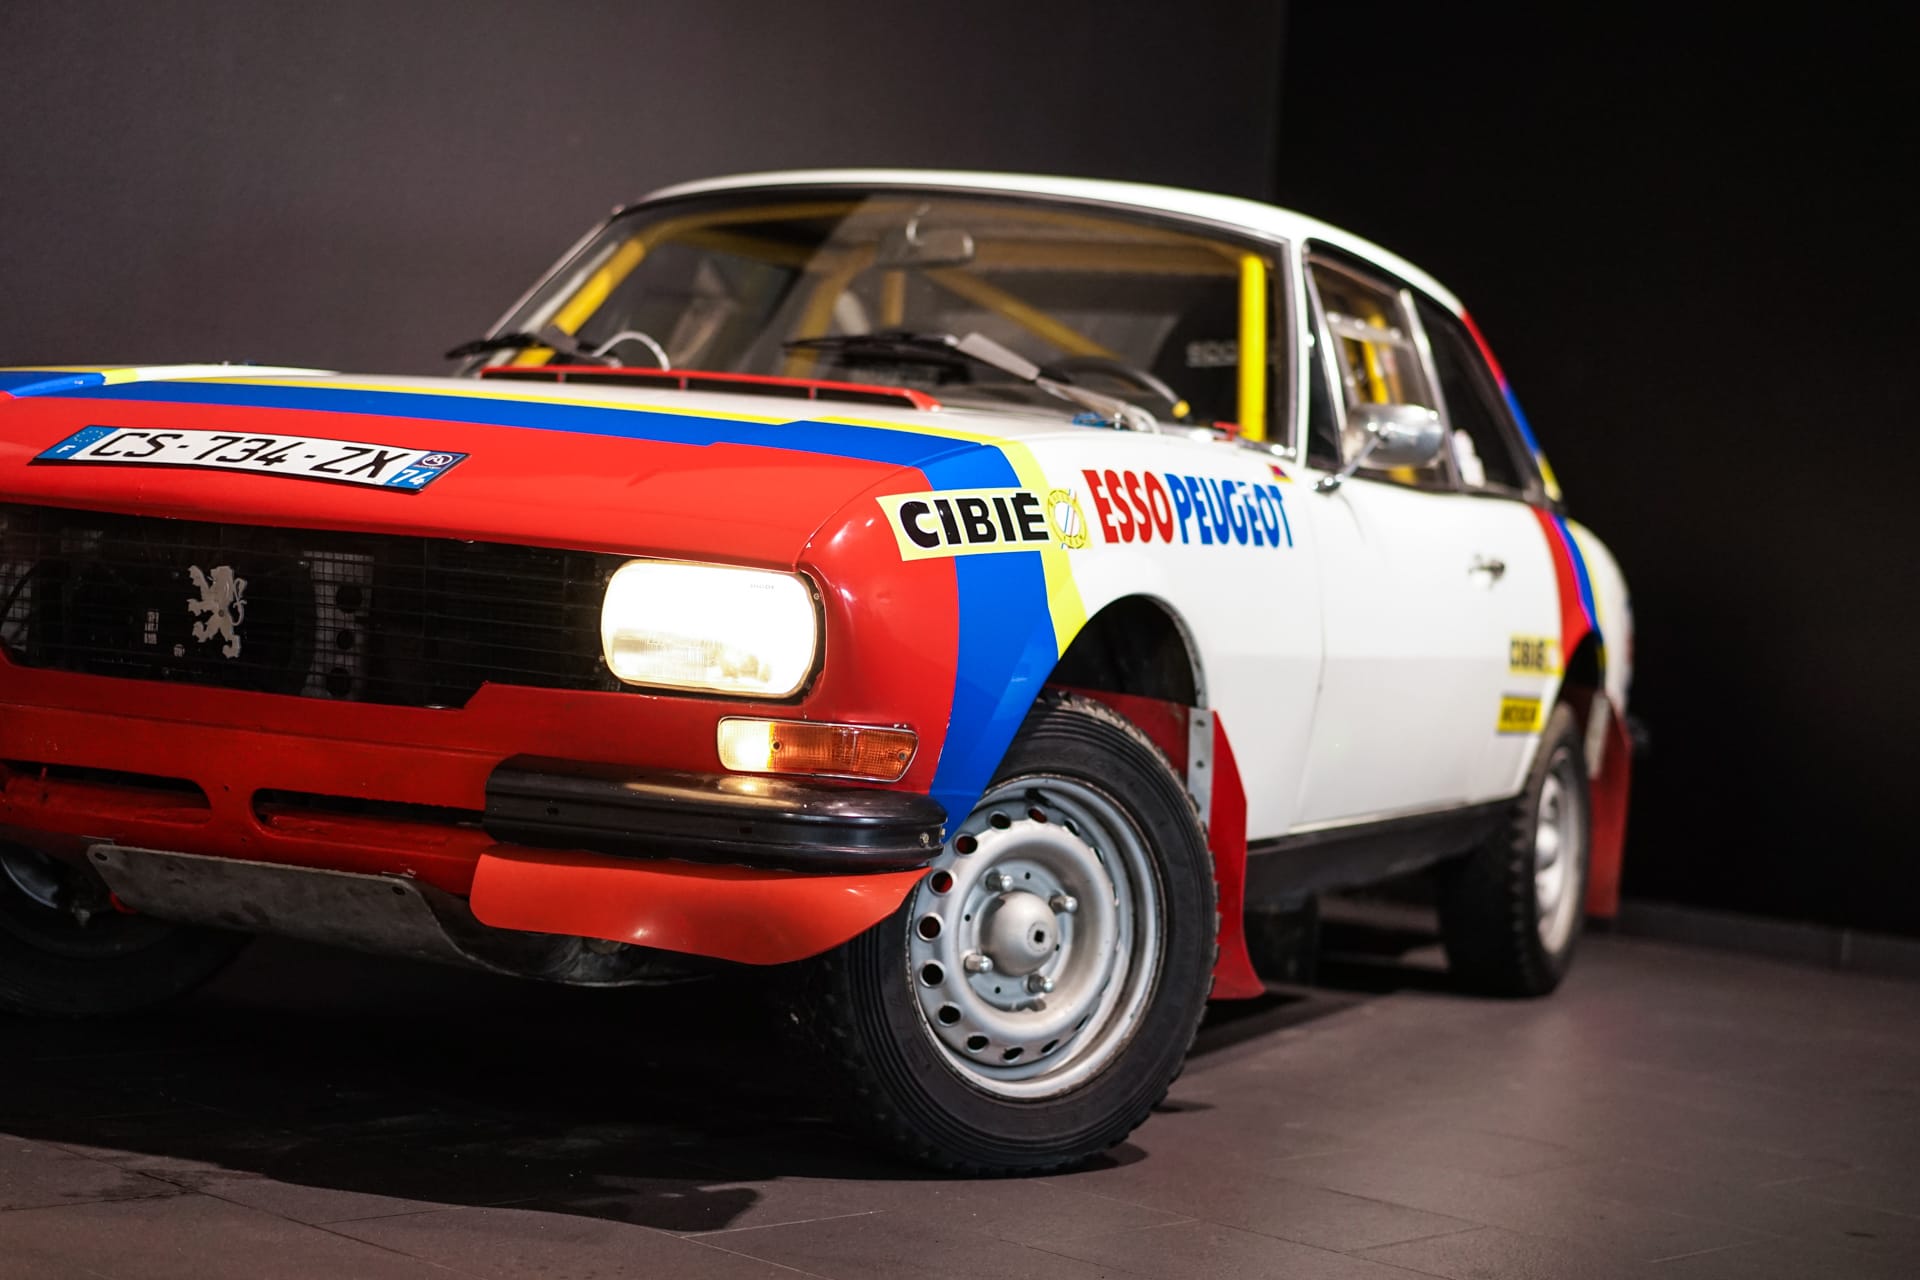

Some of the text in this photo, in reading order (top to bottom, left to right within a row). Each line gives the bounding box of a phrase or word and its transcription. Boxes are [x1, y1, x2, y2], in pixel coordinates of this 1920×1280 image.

[56, 444, 75, 455] F
[392, 469, 434, 486] 74
[899, 493, 1050, 549] CIBIÉ
[1081, 470, 1294, 549] ESSO PEUGEOT
